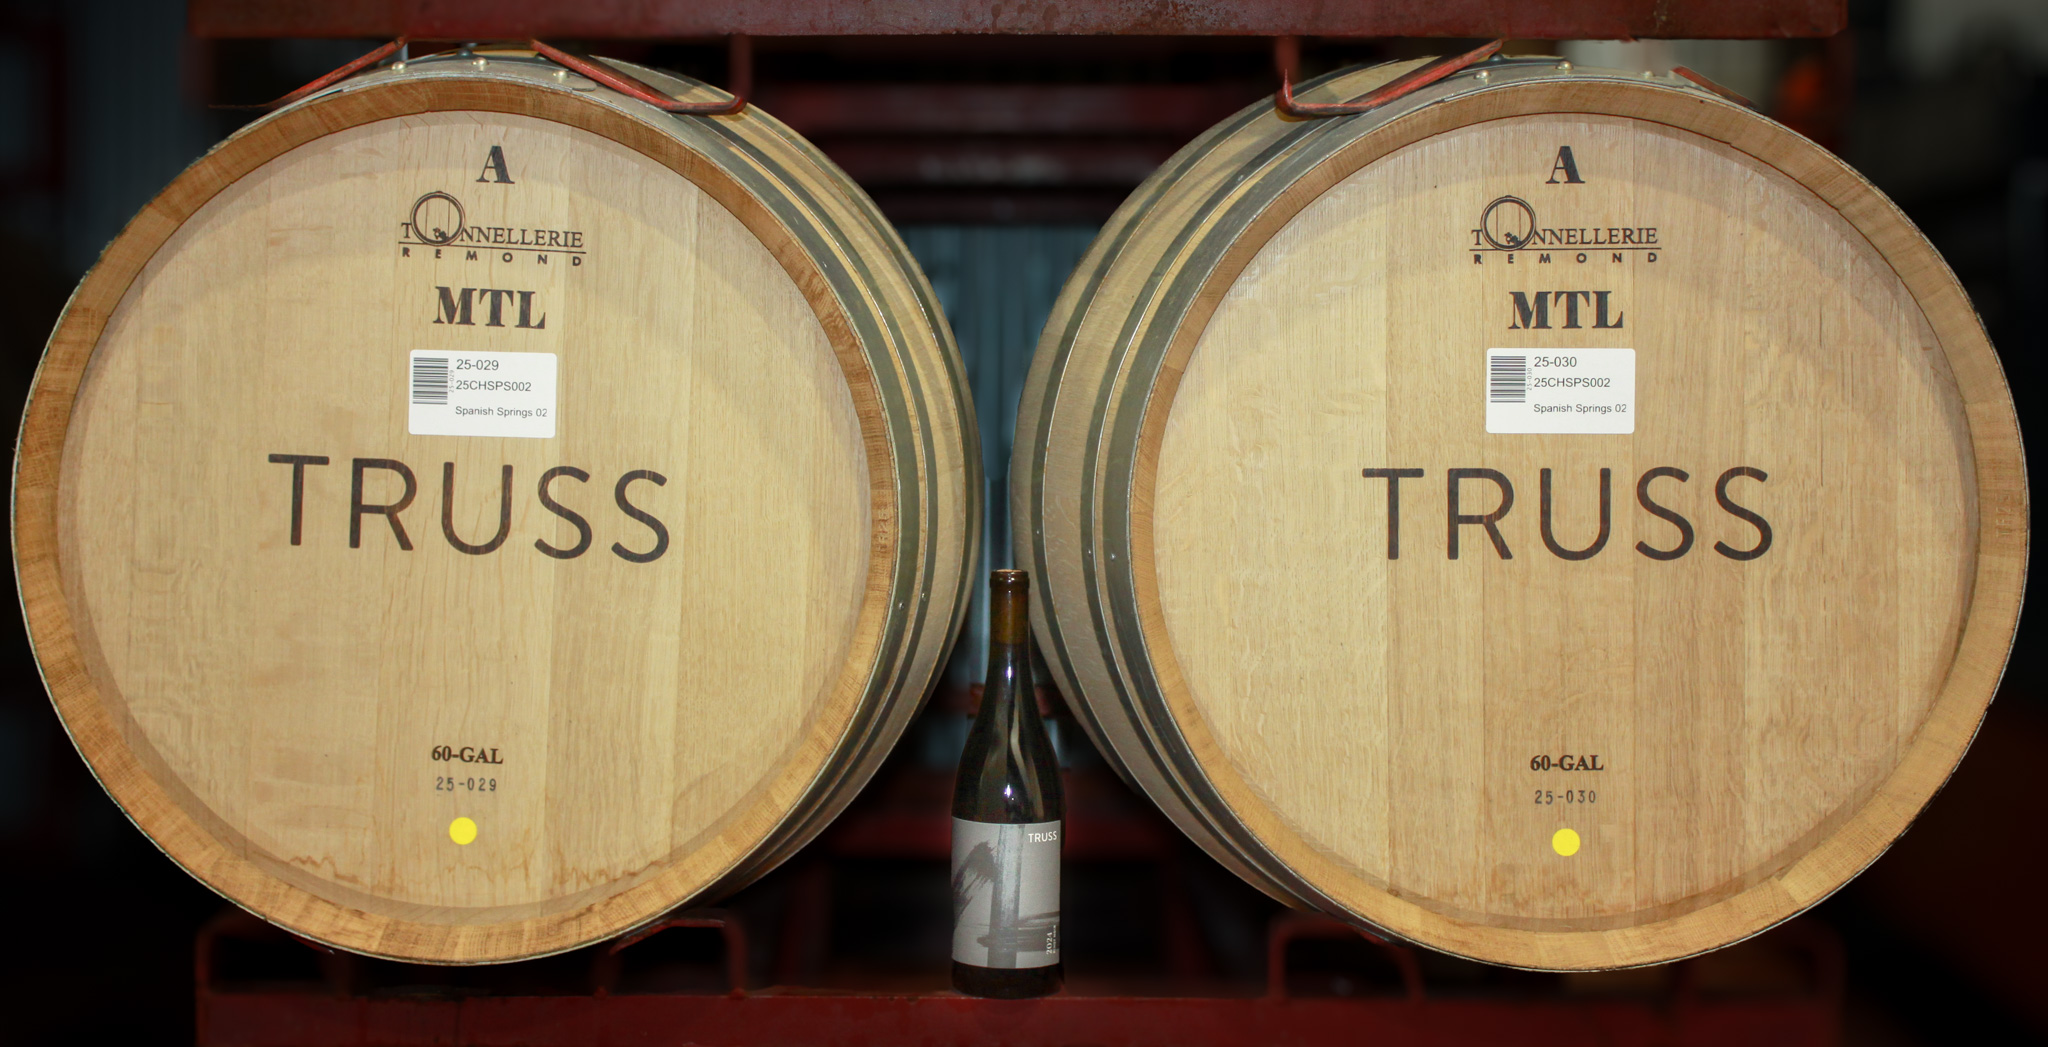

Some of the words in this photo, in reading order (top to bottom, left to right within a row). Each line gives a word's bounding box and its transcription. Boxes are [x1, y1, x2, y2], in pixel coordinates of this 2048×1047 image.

[476, 145, 515, 184] A
[1545, 145, 1586, 184] A
[401, 191, 584, 248] TONNELLERIE
[1471, 195, 1659, 251] TONNELLERIE
[402, 247, 582, 266] REMOND
[1473, 252, 1657, 264] REMOND
[432, 286, 546, 329] MTL
[1508, 290, 1623, 329] MTL
[456, 358, 499, 371] 25-029
[1534, 356, 1577, 368] 25-030
[455, 380, 532, 392] 25CHSPS002
[1533, 377, 1611, 388] 25CHSPS002
[455, 405, 494, 417] Spanish
[497, 407, 533, 419] Springs
[536, 408, 548, 417] 02
[1533, 403, 1572, 414] Spanish
[1575, 403, 1612, 415] Springs
[1615, 404, 1627, 413] 02
[268, 453, 670, 564] TRUSS
[1362, 466, 1773, 561] TRUSS
[431, 745, 504, 765] 60-GAL
[1530, 755, 1604, 771] 60-GAL
[436, 776, 497, 792] 25-029
[1534, 790, 1597, 805] 25-030
[1028, 831, 1058, 843] TRUSS
